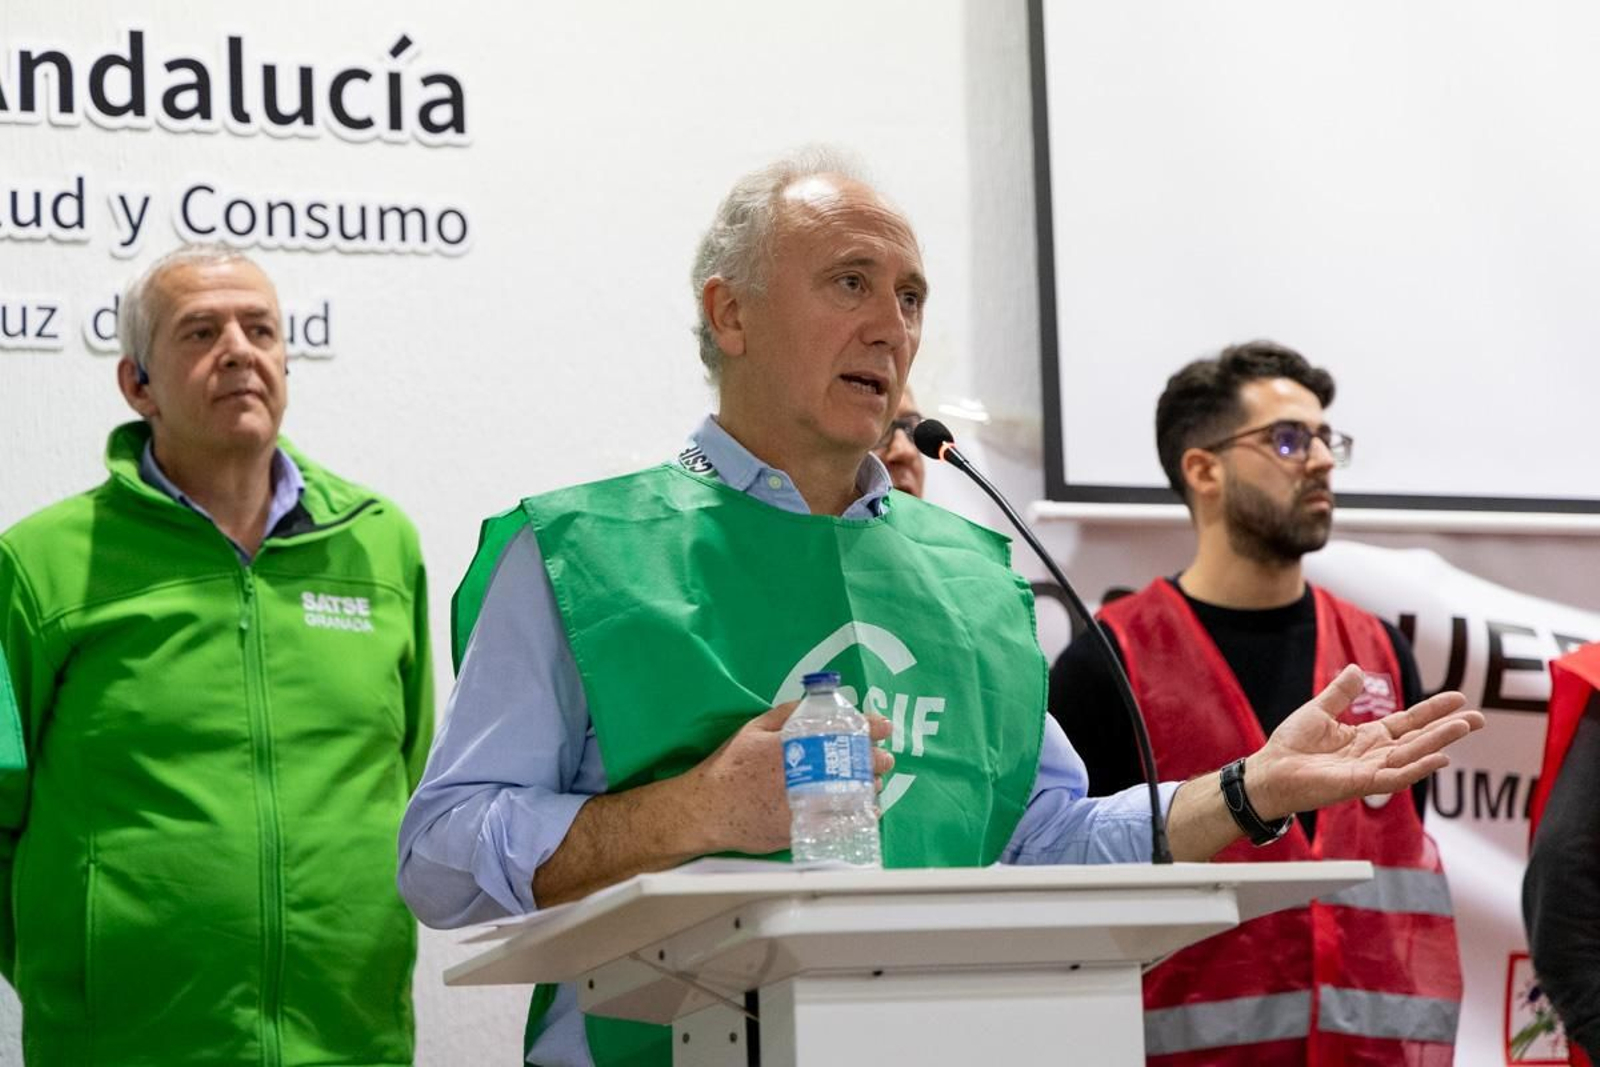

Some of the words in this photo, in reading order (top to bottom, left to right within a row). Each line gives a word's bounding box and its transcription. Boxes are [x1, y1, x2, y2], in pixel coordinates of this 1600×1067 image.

[0, 30, 467, 134] ndalucía
[0, 176, 85, 229] ud
[118, 195, 151, 247] y
[181, 184, 468, 245] Consumo
[0, 304, 59, 339] uz
[92, 294, 119, 341] d
[301, 591, 371, 617] SATSE
[1398, 613, 1592, 715] UE
[1430, 767, 1542, 821] UM
